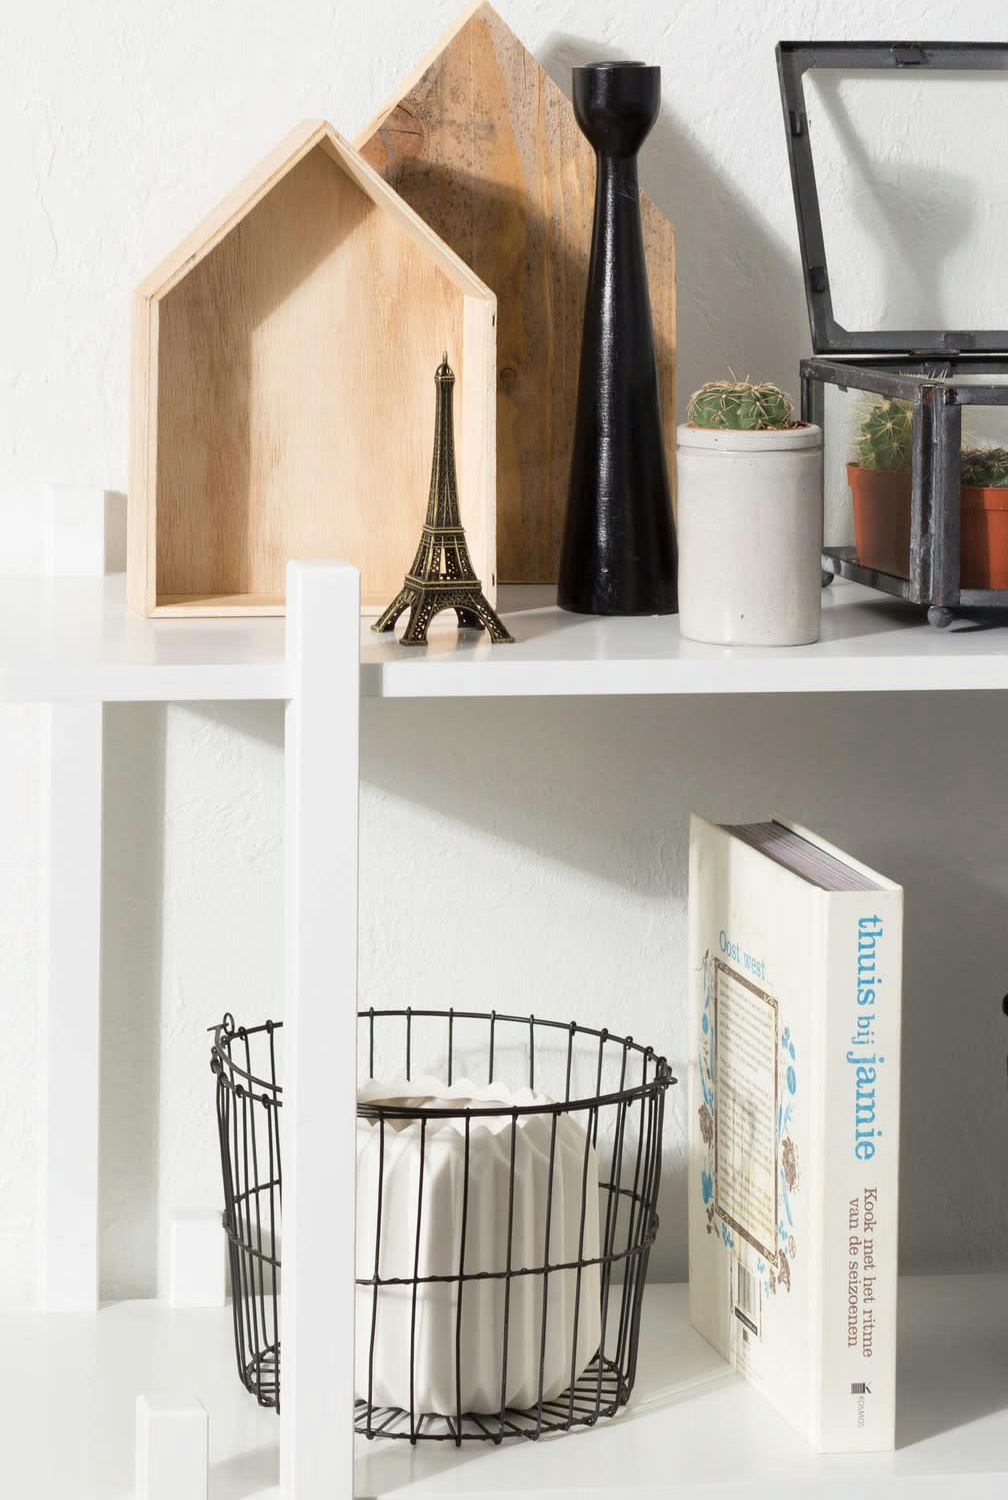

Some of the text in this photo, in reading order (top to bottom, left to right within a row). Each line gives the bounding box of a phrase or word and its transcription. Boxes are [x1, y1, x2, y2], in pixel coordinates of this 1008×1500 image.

[719, 929, 740, 963] Oost
[846, 915, 886, 1161] thuis bij jamie
[847, 1197, 862, 1348] van de seizoenen
[862, 1187, 878, 1358] Kook met het ritme
[857, 1395, 865, 1429] KOSMOS
